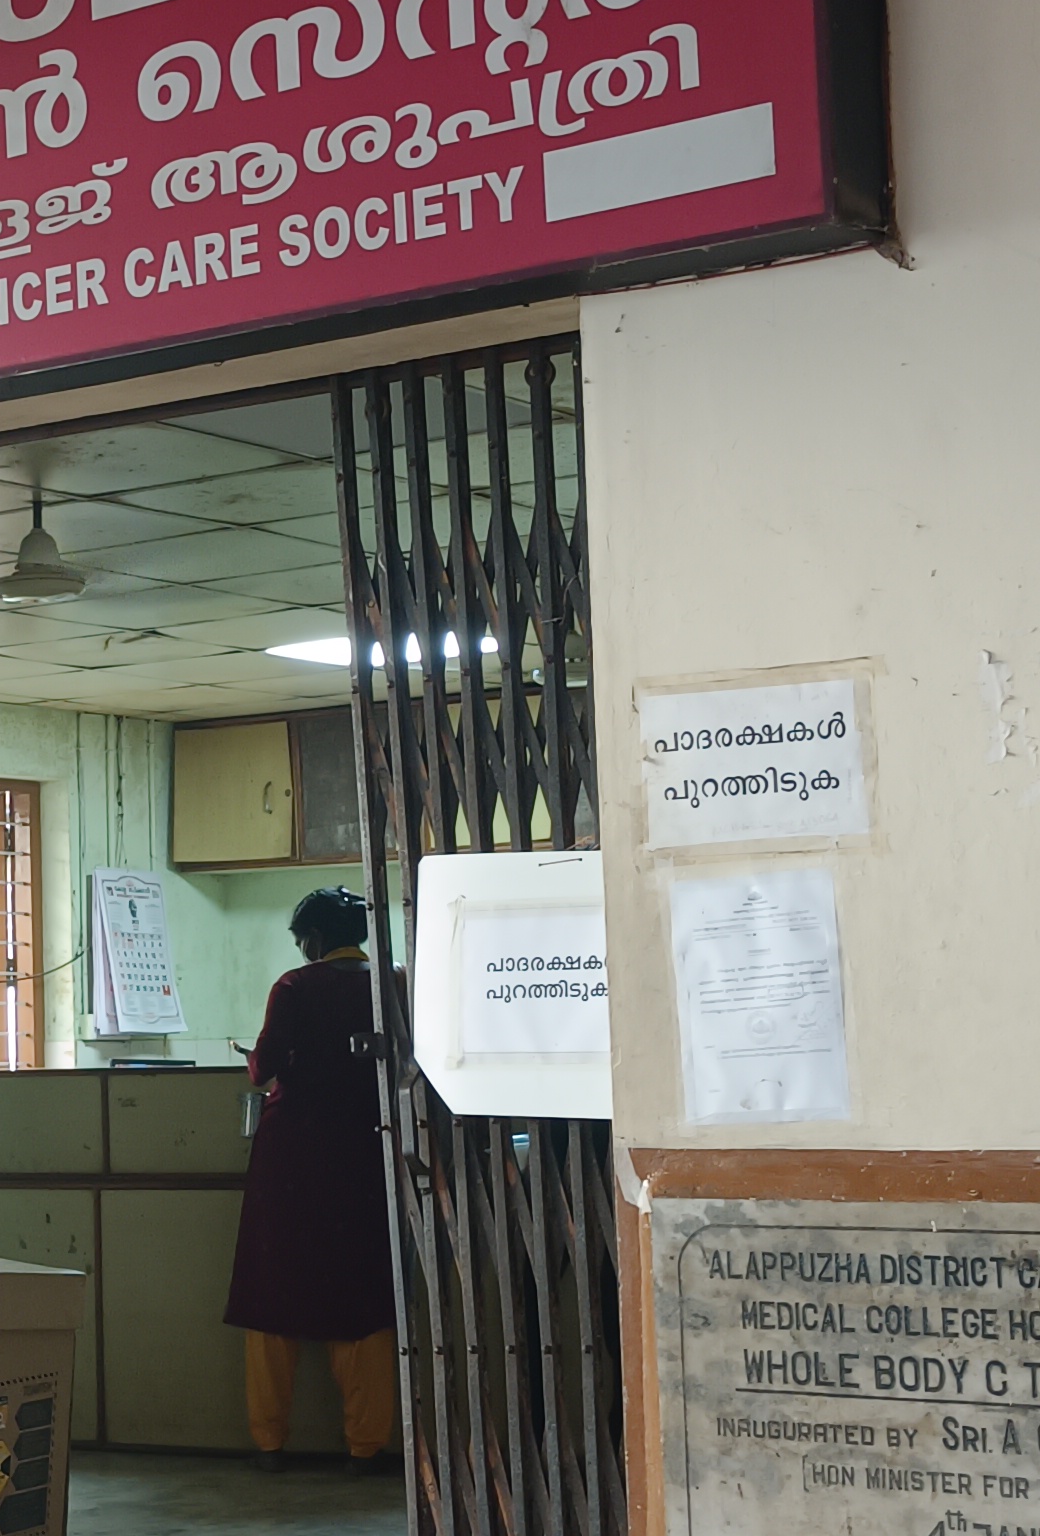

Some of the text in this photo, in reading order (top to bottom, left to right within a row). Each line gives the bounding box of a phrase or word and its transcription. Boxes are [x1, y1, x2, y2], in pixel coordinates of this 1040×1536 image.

[150, 24, 703, 210] ആശുപത്രി
[123, 224, 261, 298] CARE
[278, 167, 526, 267] SOCIETY
[654, 711, 847, 754] പാദരക്ഷകൾ
[663, 766, 840, 809] പുറത്തിടുക
[486, 955, 608, 973] പാദരക്ഷക
[486, 979, 609, 1003] പുറത്തിടുക
[709, 1249, 871, 1284] ALAPPUZHA
[880, 1253, 1007, 1289] DISTRICT
[741, 1300, 856, 1331] MEDICAL
[865, 1304, 1000, 1340] COLLEGE
[743, 1348, 860, 1389] WHOLE
[873, 1355, 970, 1394] BODY
[985, 1359, 1008, 1397] C
[716, 1417, 875, 1446] INAUGURATED
[886, 1427, 919, 1449] BY
[865, 1467, 972, 1496] MINISTER
[983, 1475, 1029, 1499] FOR
